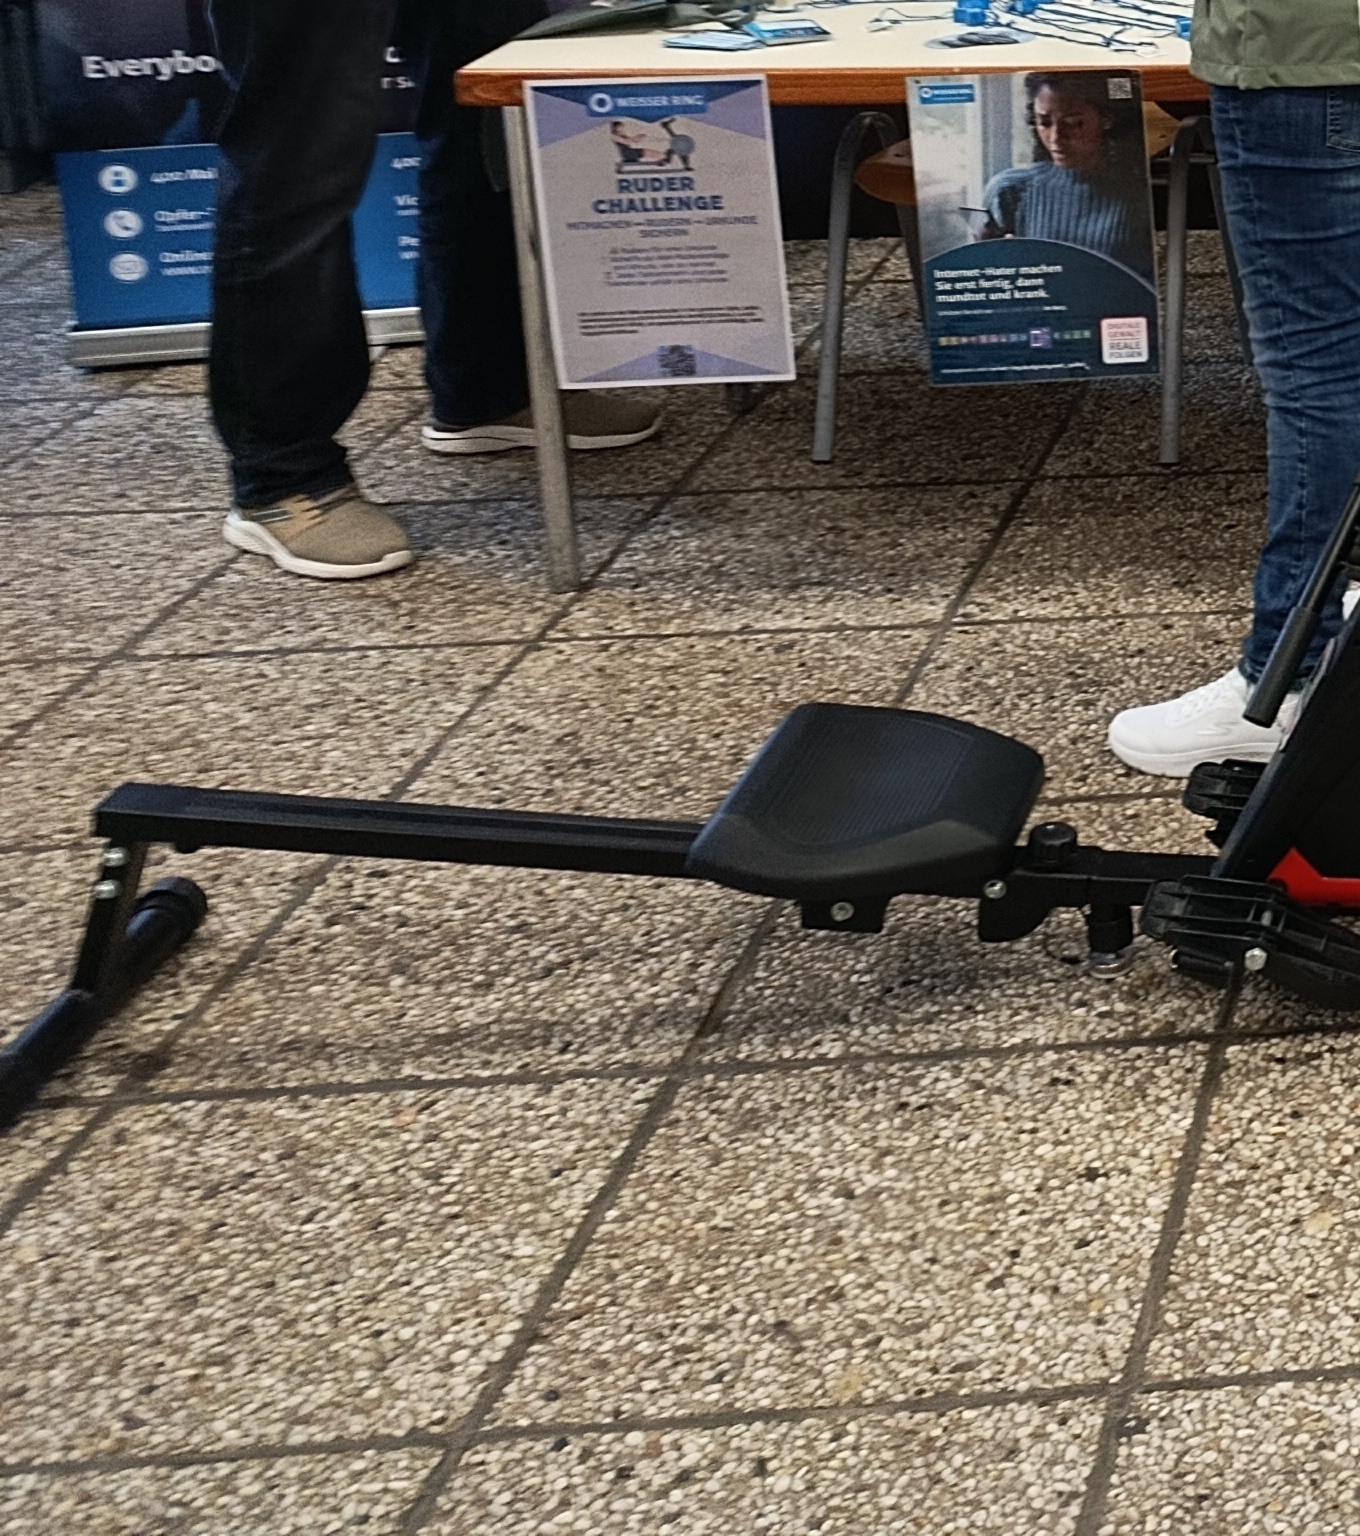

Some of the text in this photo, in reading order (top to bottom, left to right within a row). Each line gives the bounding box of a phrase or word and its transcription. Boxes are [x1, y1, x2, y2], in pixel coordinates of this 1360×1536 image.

[81, 49, 222, 81] Everybo
[616, 95, 705, 107] WEISSER RING
[616, 176, 695, 193] RUDER
[592, 195, 725, 214] CHALLENGE
[933, 264, 1063, 279] Internet-Hater machen
[934, 281, 952, 290] Sie
[954, 280, 977, 290] erst
[1015, 277, 1045, 287] dann
[988, 290, 1012, 300] und
[1109, 342, 1141, 351] REALE
